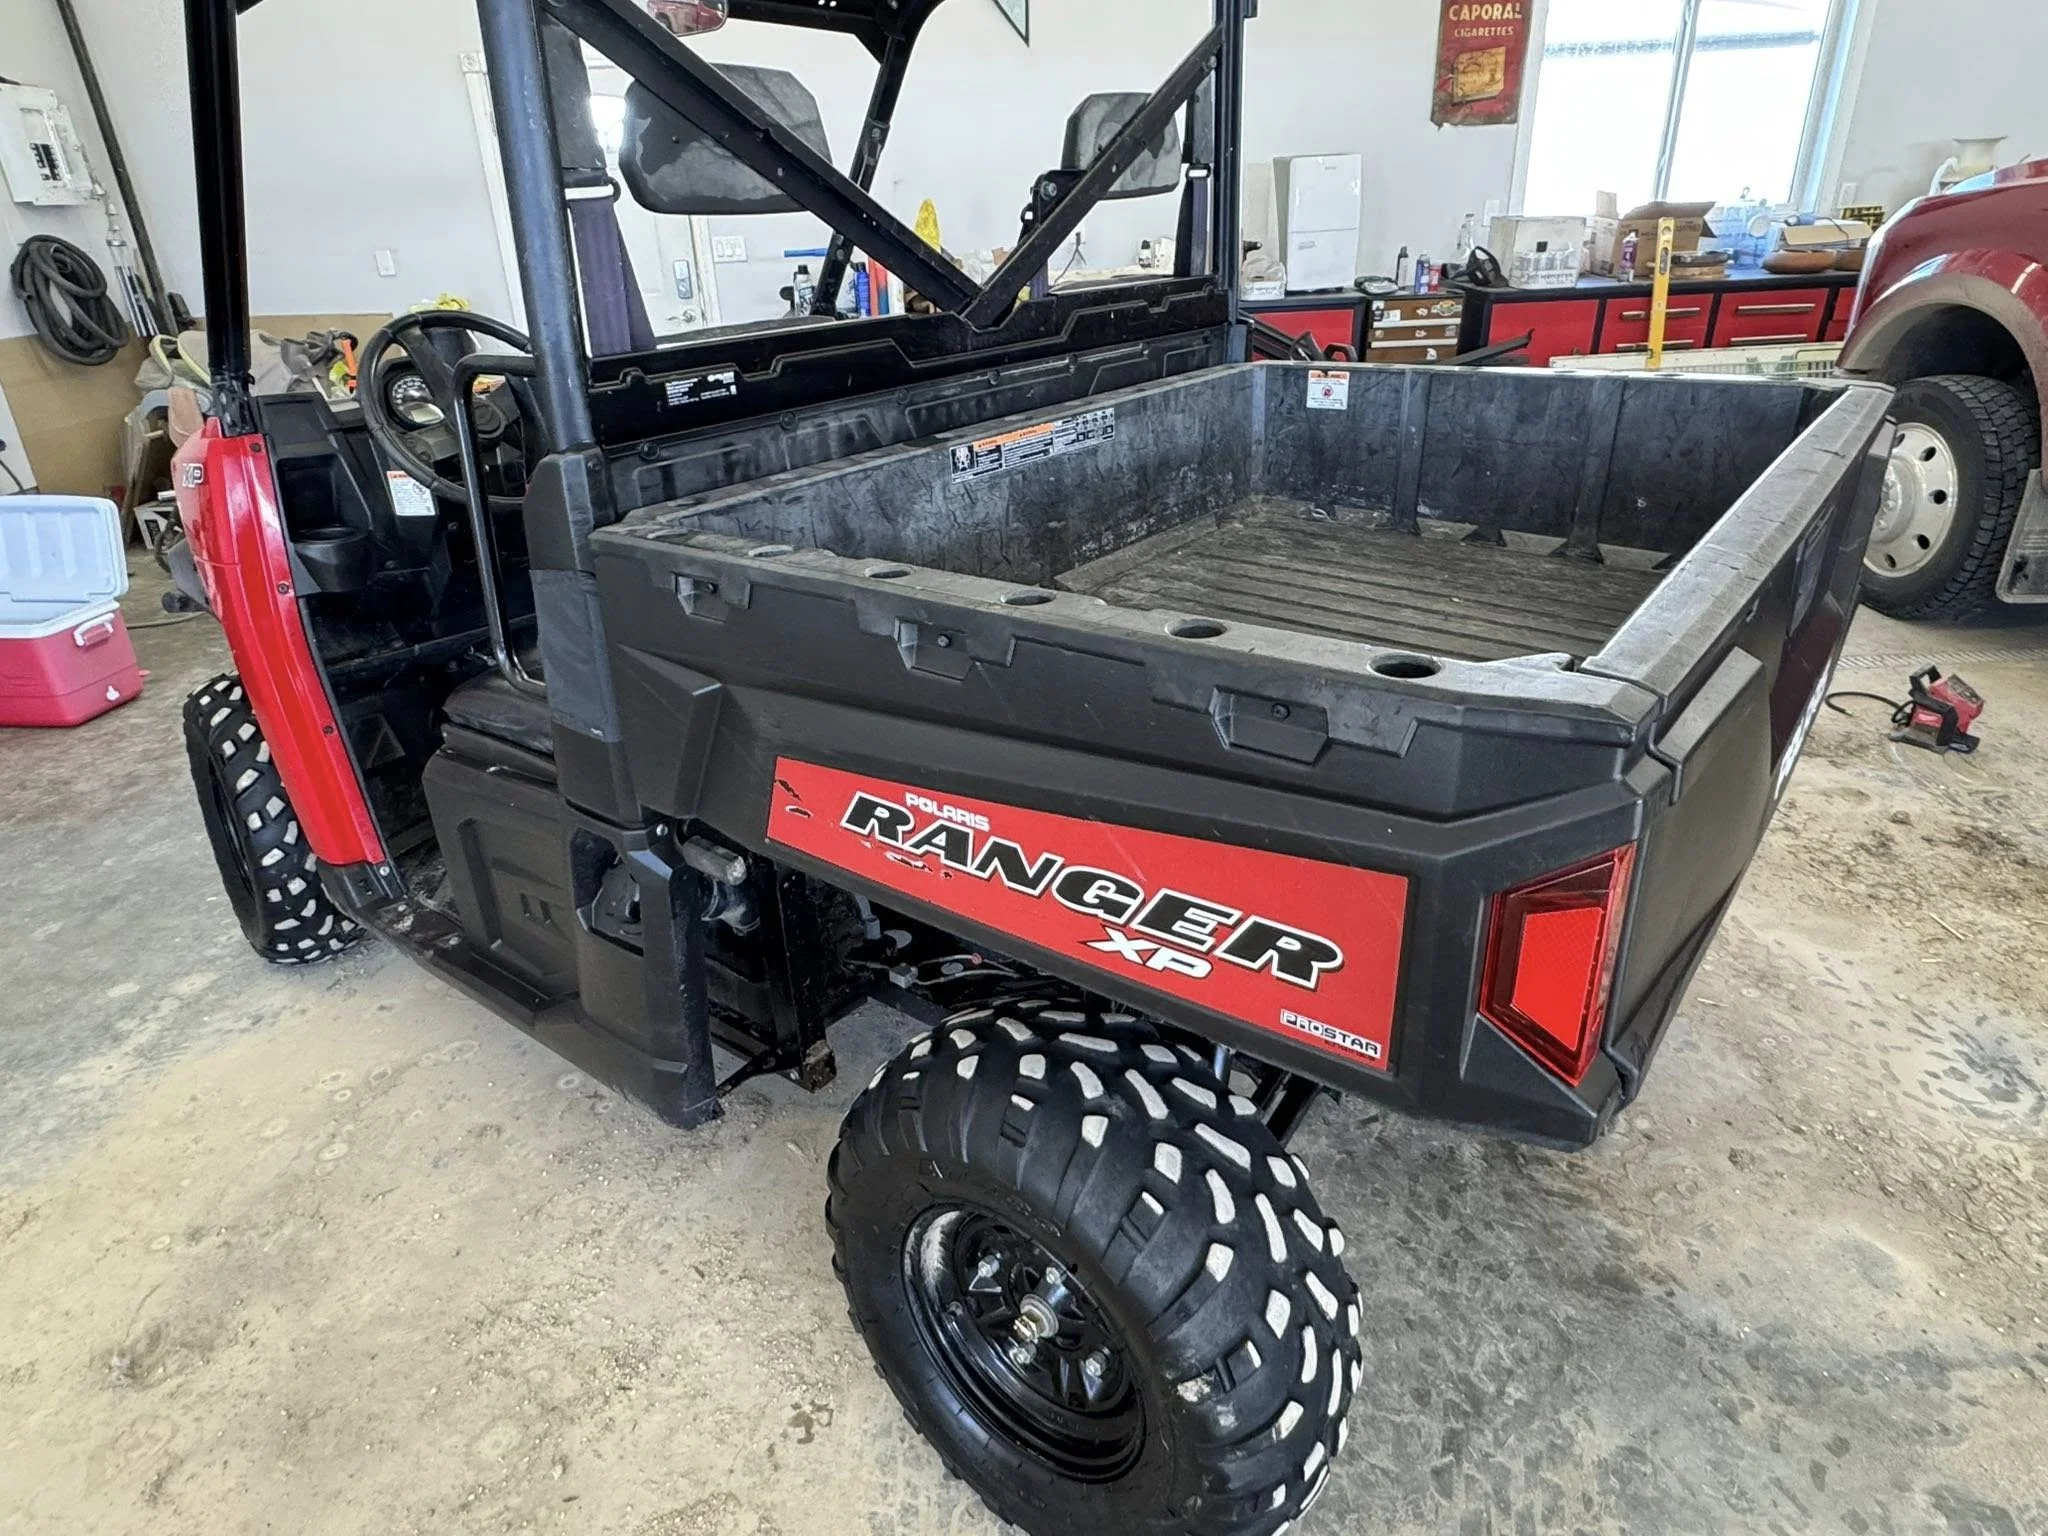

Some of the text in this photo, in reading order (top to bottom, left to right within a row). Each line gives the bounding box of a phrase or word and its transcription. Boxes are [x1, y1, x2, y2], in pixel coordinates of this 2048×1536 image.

[1448, 2, 1522, 21] CAPORAL
[1454, 26, 1514, 38] CIGARETTES
[182, 463, 204, 488] XP
[905, 791, 990, 832] POLARIS
[840, 791, 1344, 990] RANGER
[1087, 926, 1214, 980] XP
[1281, 1009, 1381, 1058] PROSTAR
